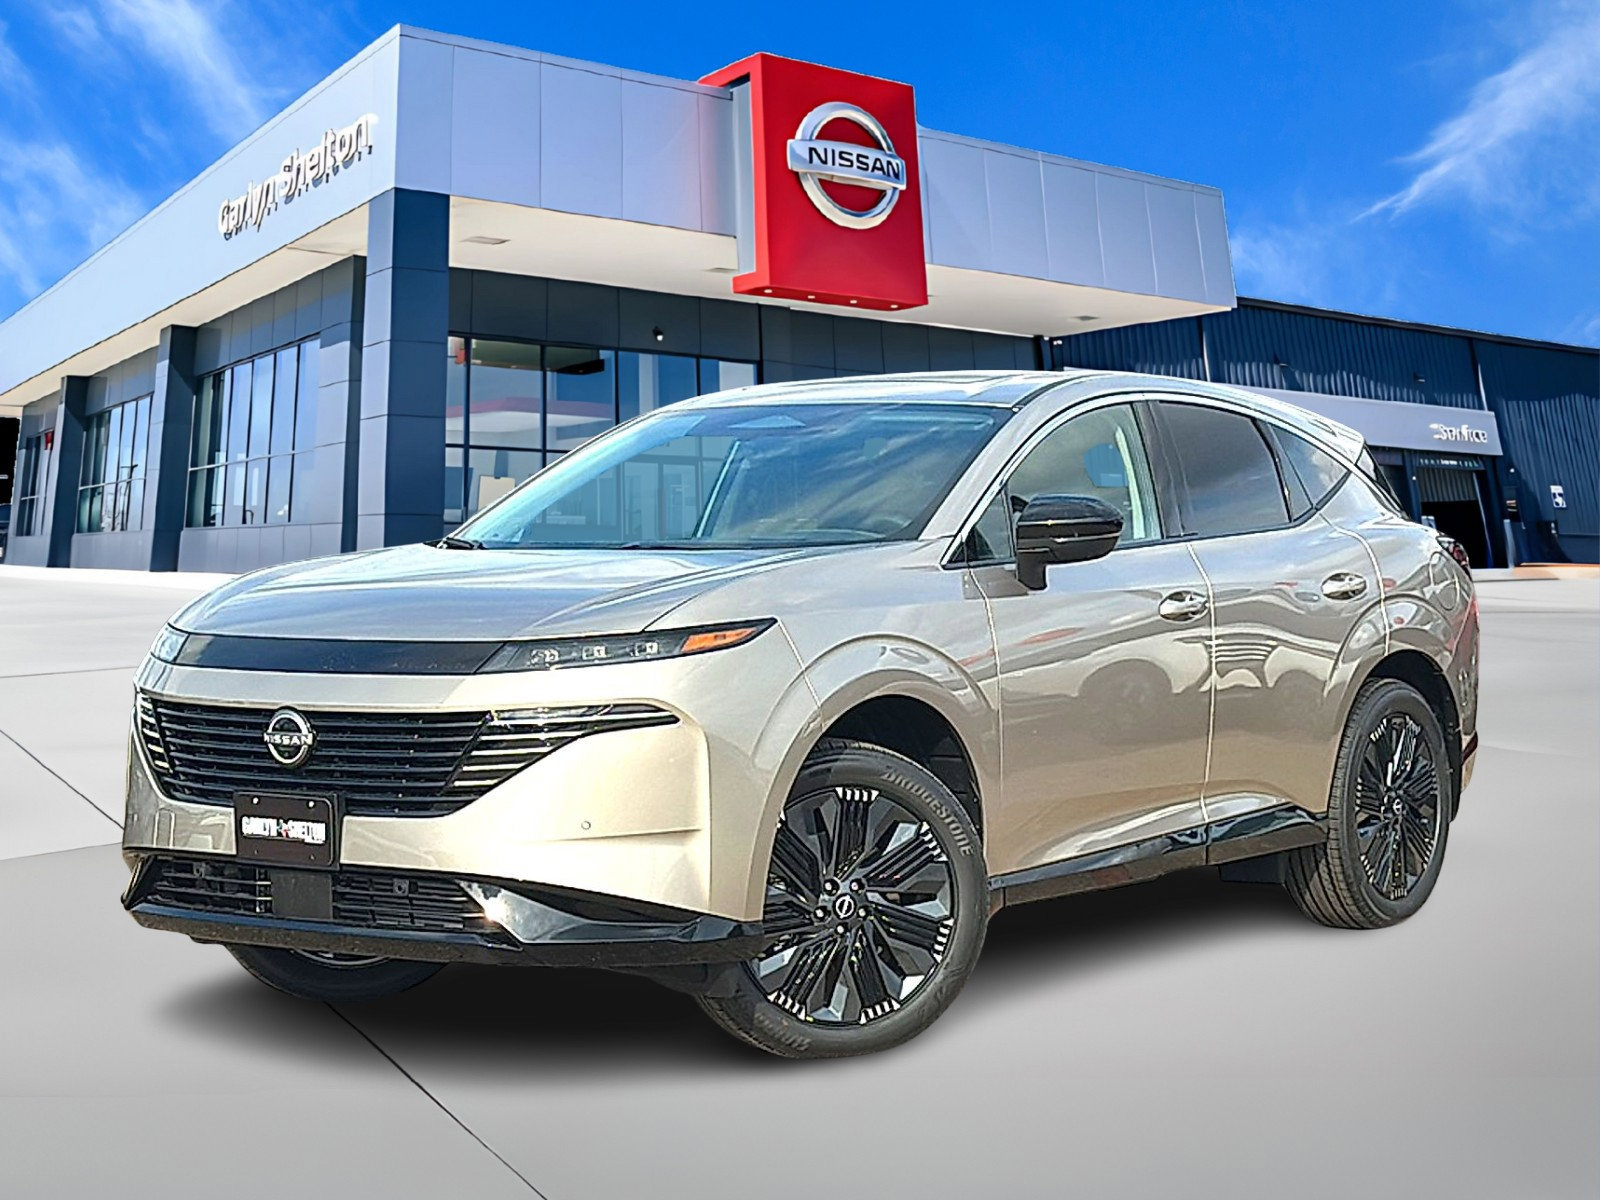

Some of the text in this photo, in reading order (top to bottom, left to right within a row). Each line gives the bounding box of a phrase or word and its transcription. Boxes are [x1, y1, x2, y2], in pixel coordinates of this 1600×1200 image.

[279, 113, 376, 205] Shelton
[807, 145, 901, 181] NISSAN
[263, 731, 314, 747] NISSAN
